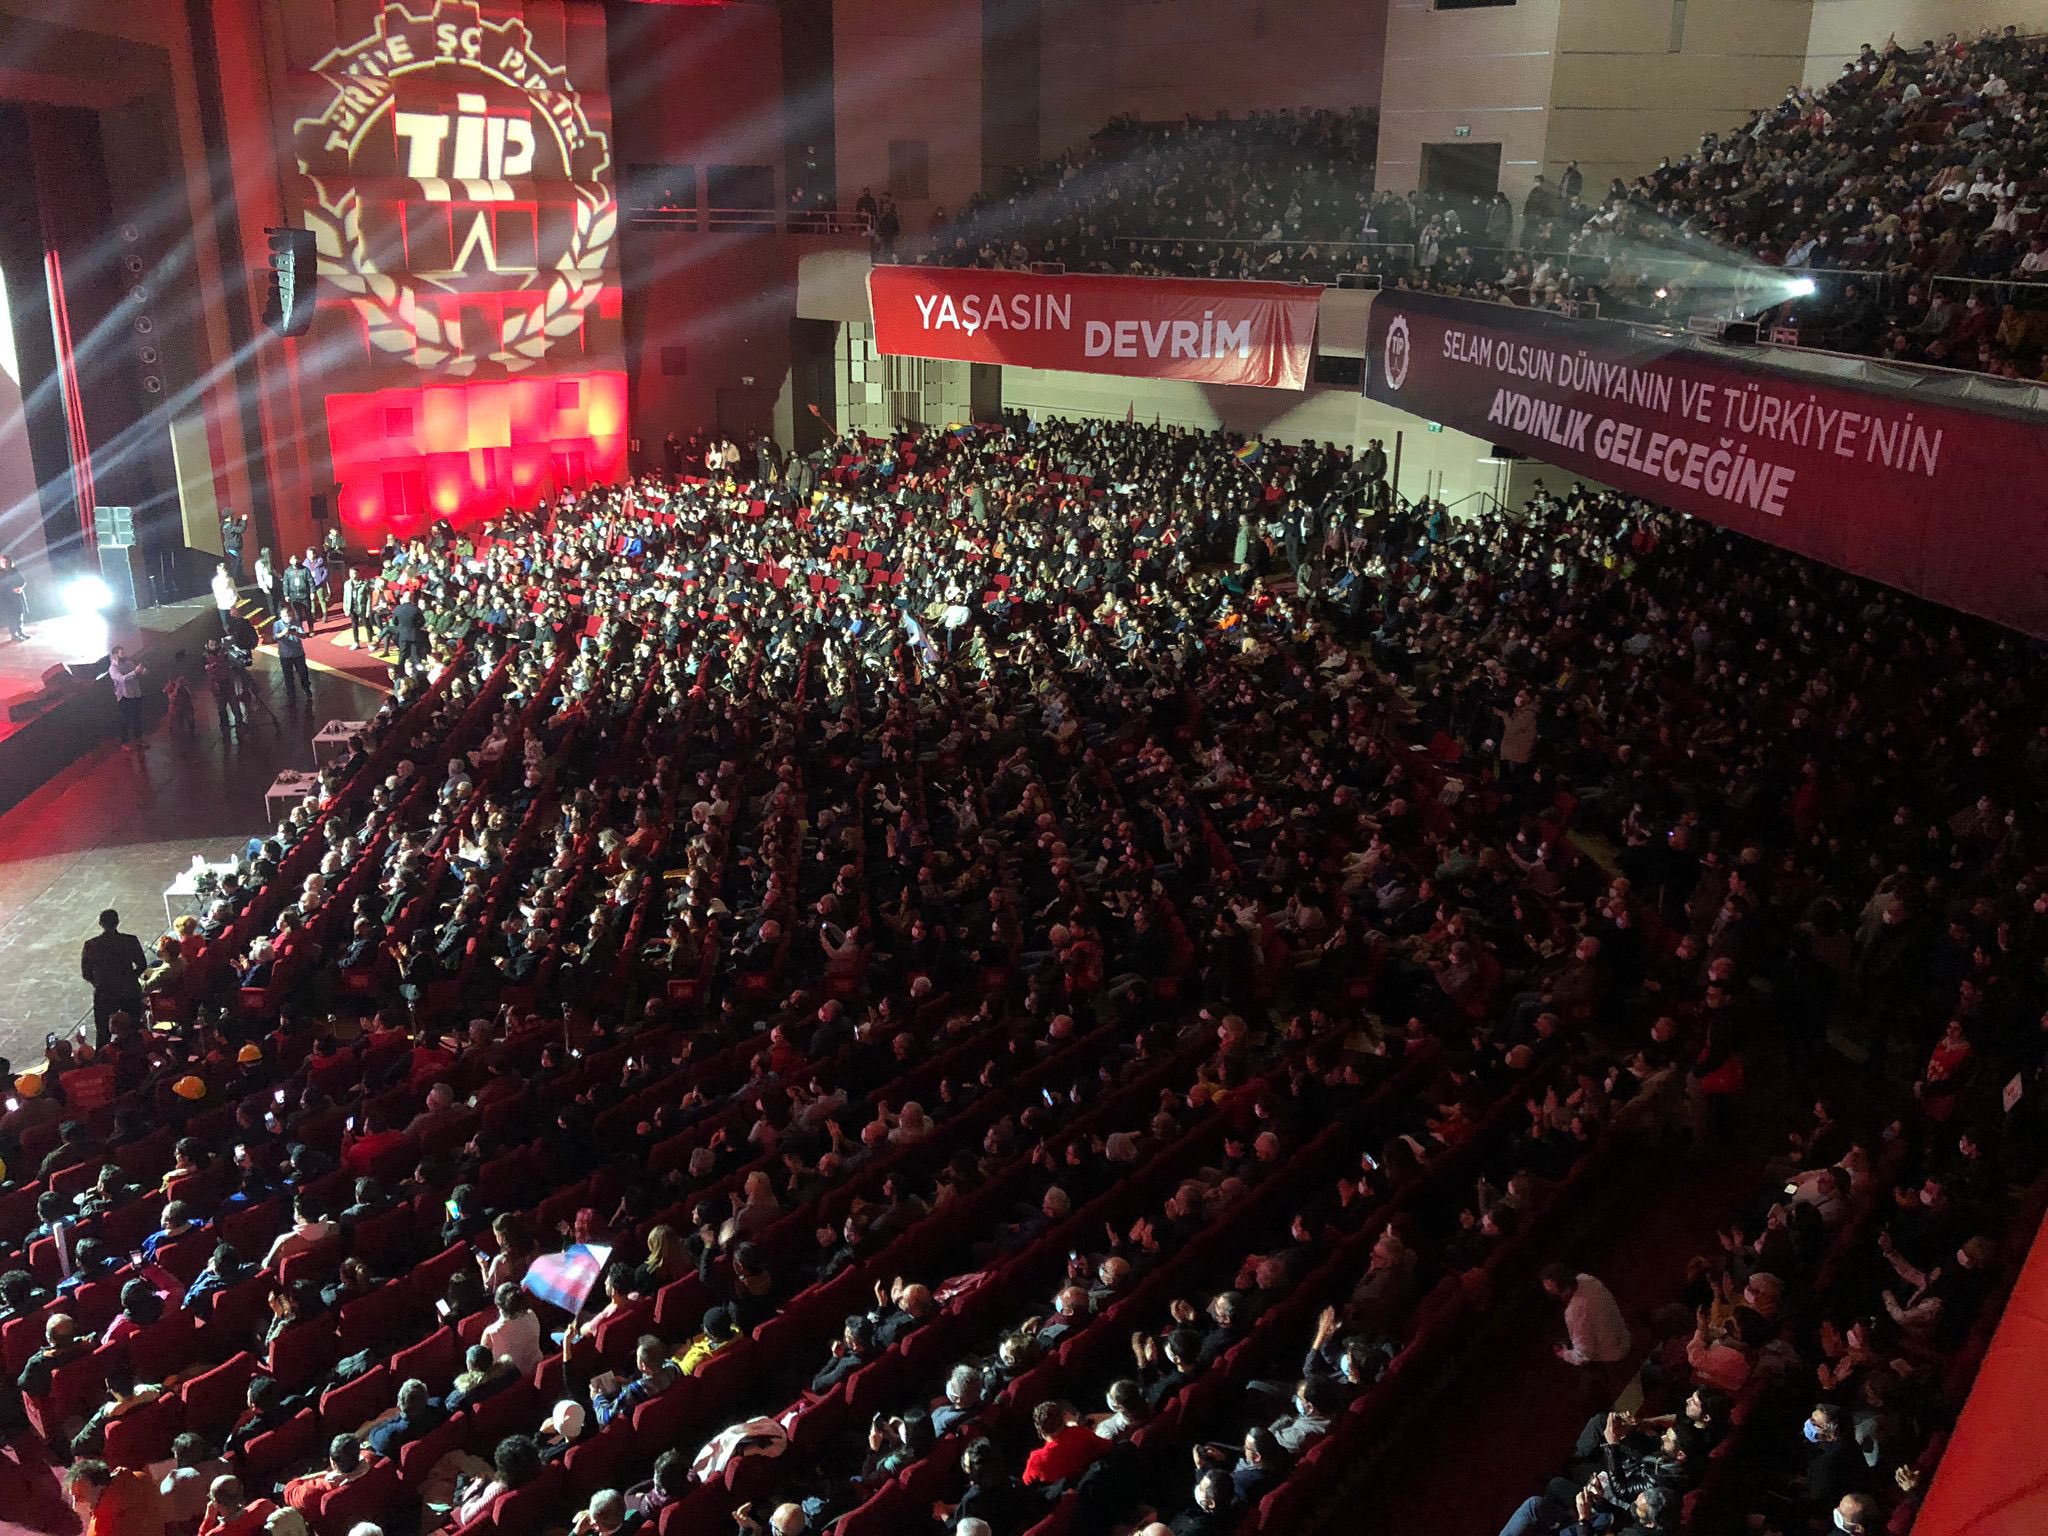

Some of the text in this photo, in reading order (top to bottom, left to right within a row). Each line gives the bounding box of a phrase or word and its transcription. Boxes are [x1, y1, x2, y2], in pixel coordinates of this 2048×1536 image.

[395, 92, 536, 201] TİP
[914, 294, 1253, 360] YAŞASIN DEVRİM
[1442, 329, 1944, 478] SELAM OLSUN DÜNYANIN VE TÜRKİYE'NİN
[1487, 388, 1797, 517] AYDINLIK GELECEĞİNE
